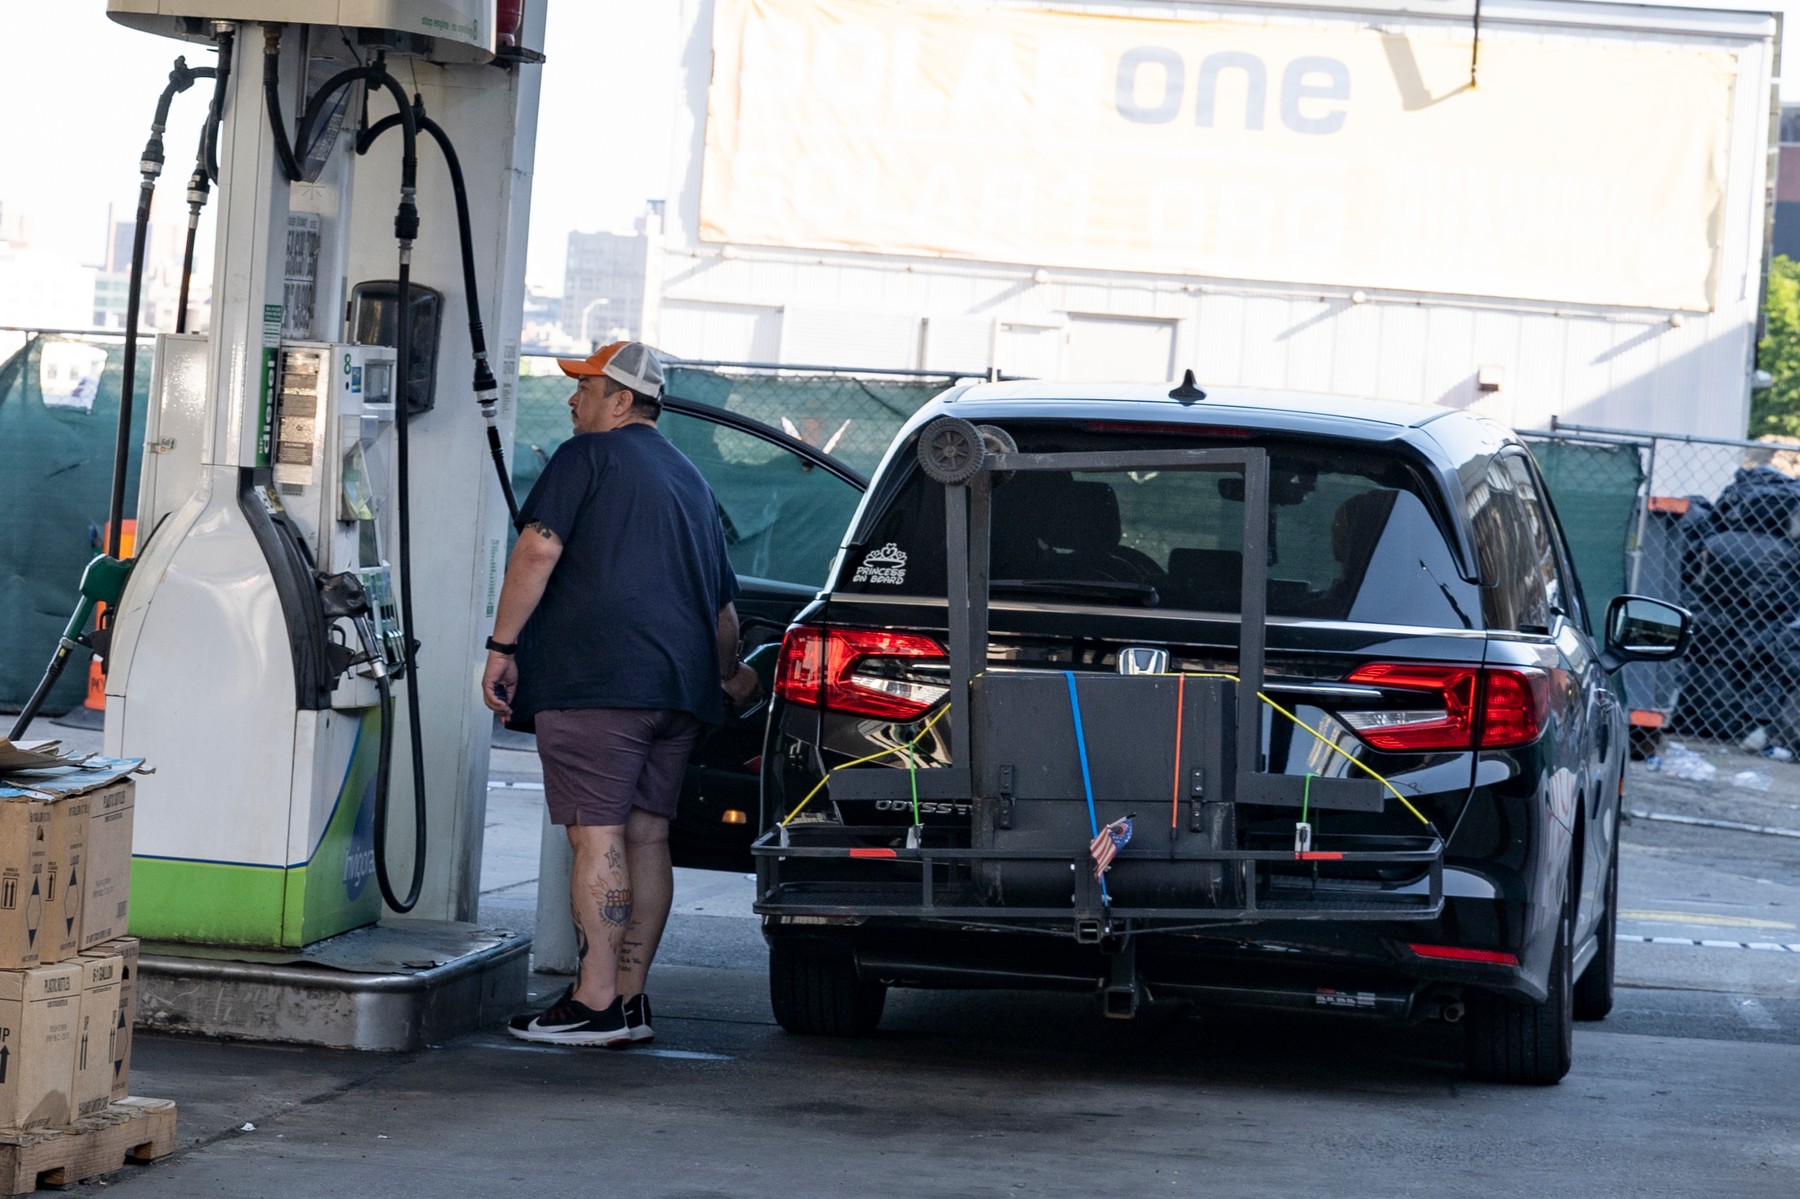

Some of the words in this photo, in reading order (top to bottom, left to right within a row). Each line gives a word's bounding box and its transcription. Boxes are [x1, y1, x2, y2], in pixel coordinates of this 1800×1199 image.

[1115, 44, 1351, 136] one
[344, 353, 352, 375] 8
[263, 360, 275, 454] diesel
[852, 575, 868, 583] ON
[870, 575, 904, 585] BOARD
[856, 566, 906, 577] PRINCESS
[875, 799, 973, 815] ODYSSE
[343, 845, 376, 887] Invigora
[0, 1027, 10, 1042] P
